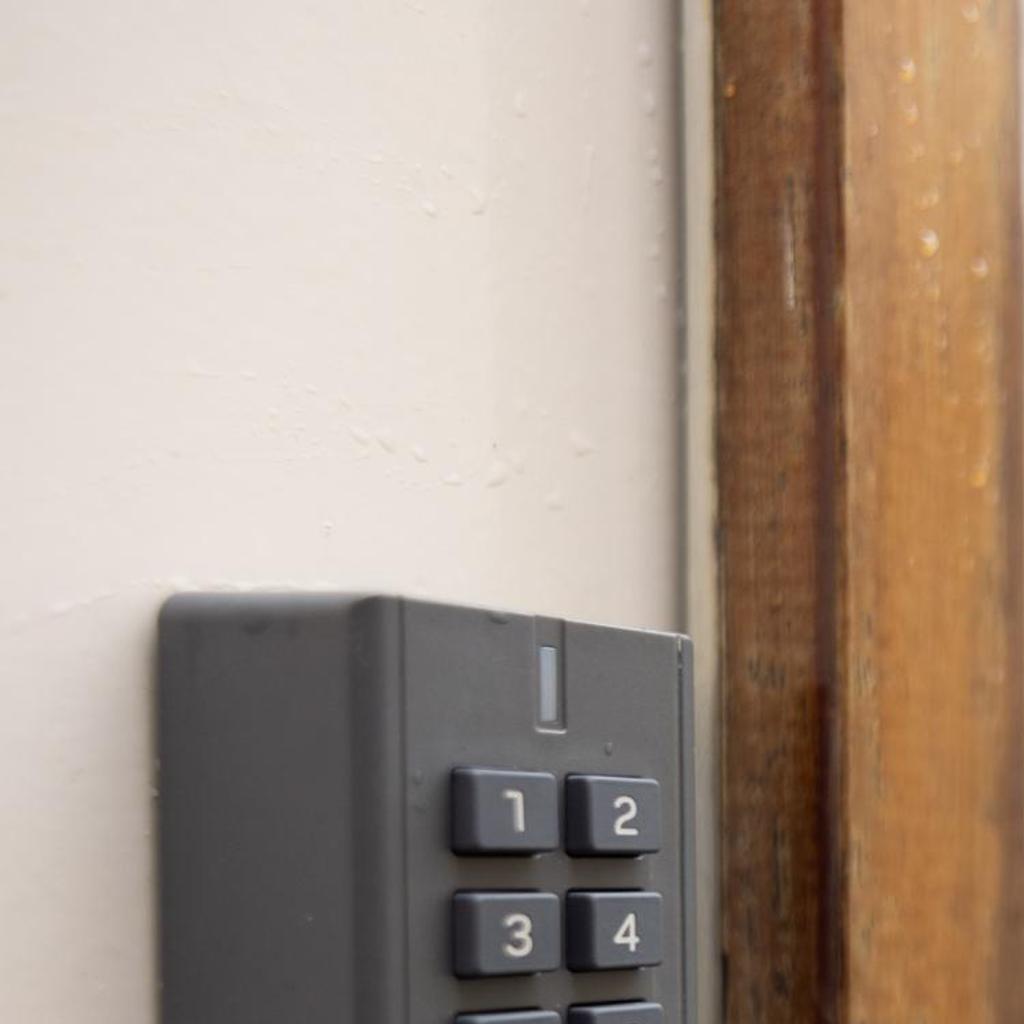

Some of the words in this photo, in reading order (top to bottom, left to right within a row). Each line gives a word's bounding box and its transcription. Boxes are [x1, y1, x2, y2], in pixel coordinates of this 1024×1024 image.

[502, 789, 527, 834] 1
[612, 795, 641, 837] 2
[502, 912, 534, 959] 3
[612, 912, 641, 953] 4
